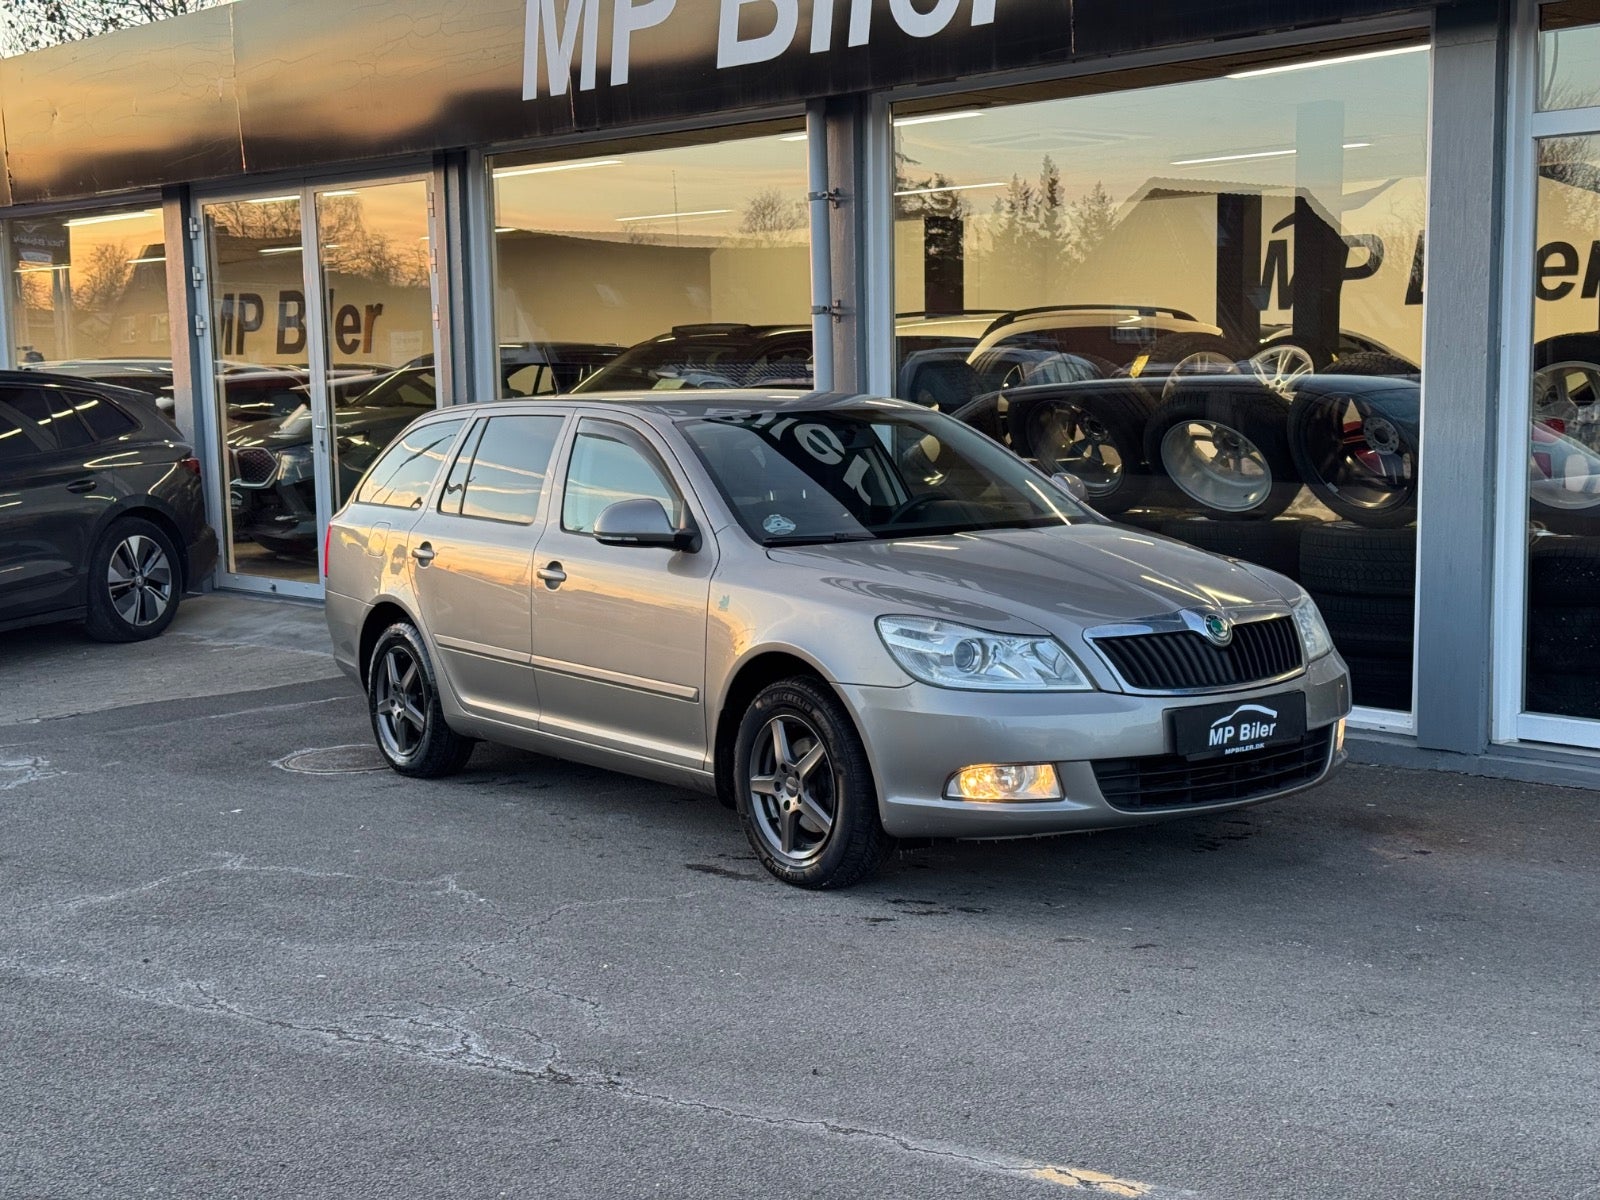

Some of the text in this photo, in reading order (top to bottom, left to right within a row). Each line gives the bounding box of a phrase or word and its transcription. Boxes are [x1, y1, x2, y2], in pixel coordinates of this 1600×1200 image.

[1209, 721, 1276, 746] MP Biler
[1224, 743, 1265, 755] MPBILER.DK
